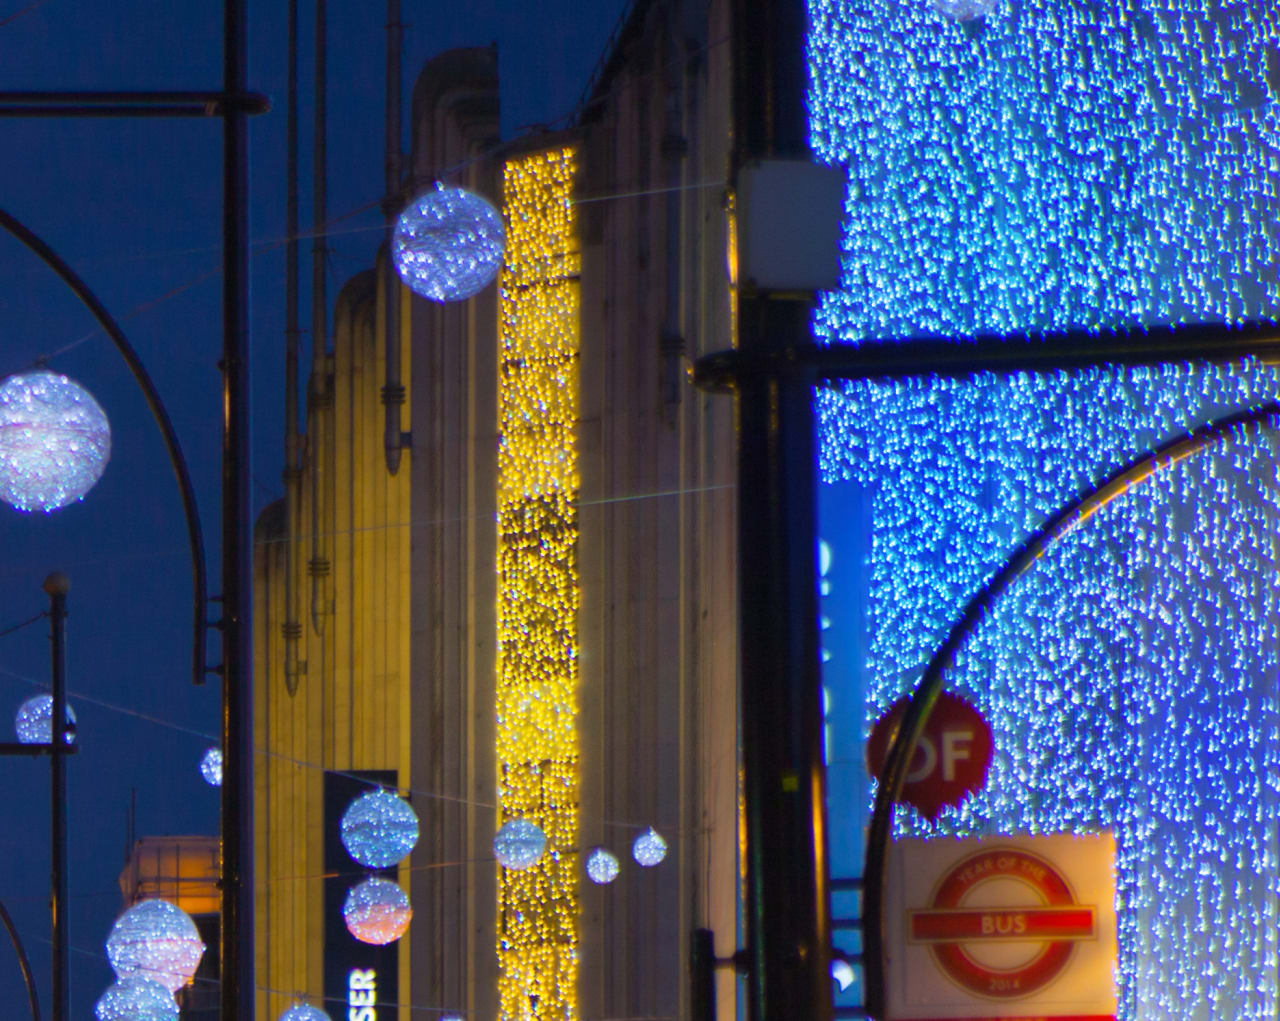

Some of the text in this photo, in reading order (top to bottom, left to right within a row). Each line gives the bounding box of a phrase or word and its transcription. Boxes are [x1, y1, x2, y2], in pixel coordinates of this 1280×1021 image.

[957, 857, 1047, 884] YEAR OF THE
[981, 915, 1027, 934] BUS
[989, 978, 1021, 990] 2014
